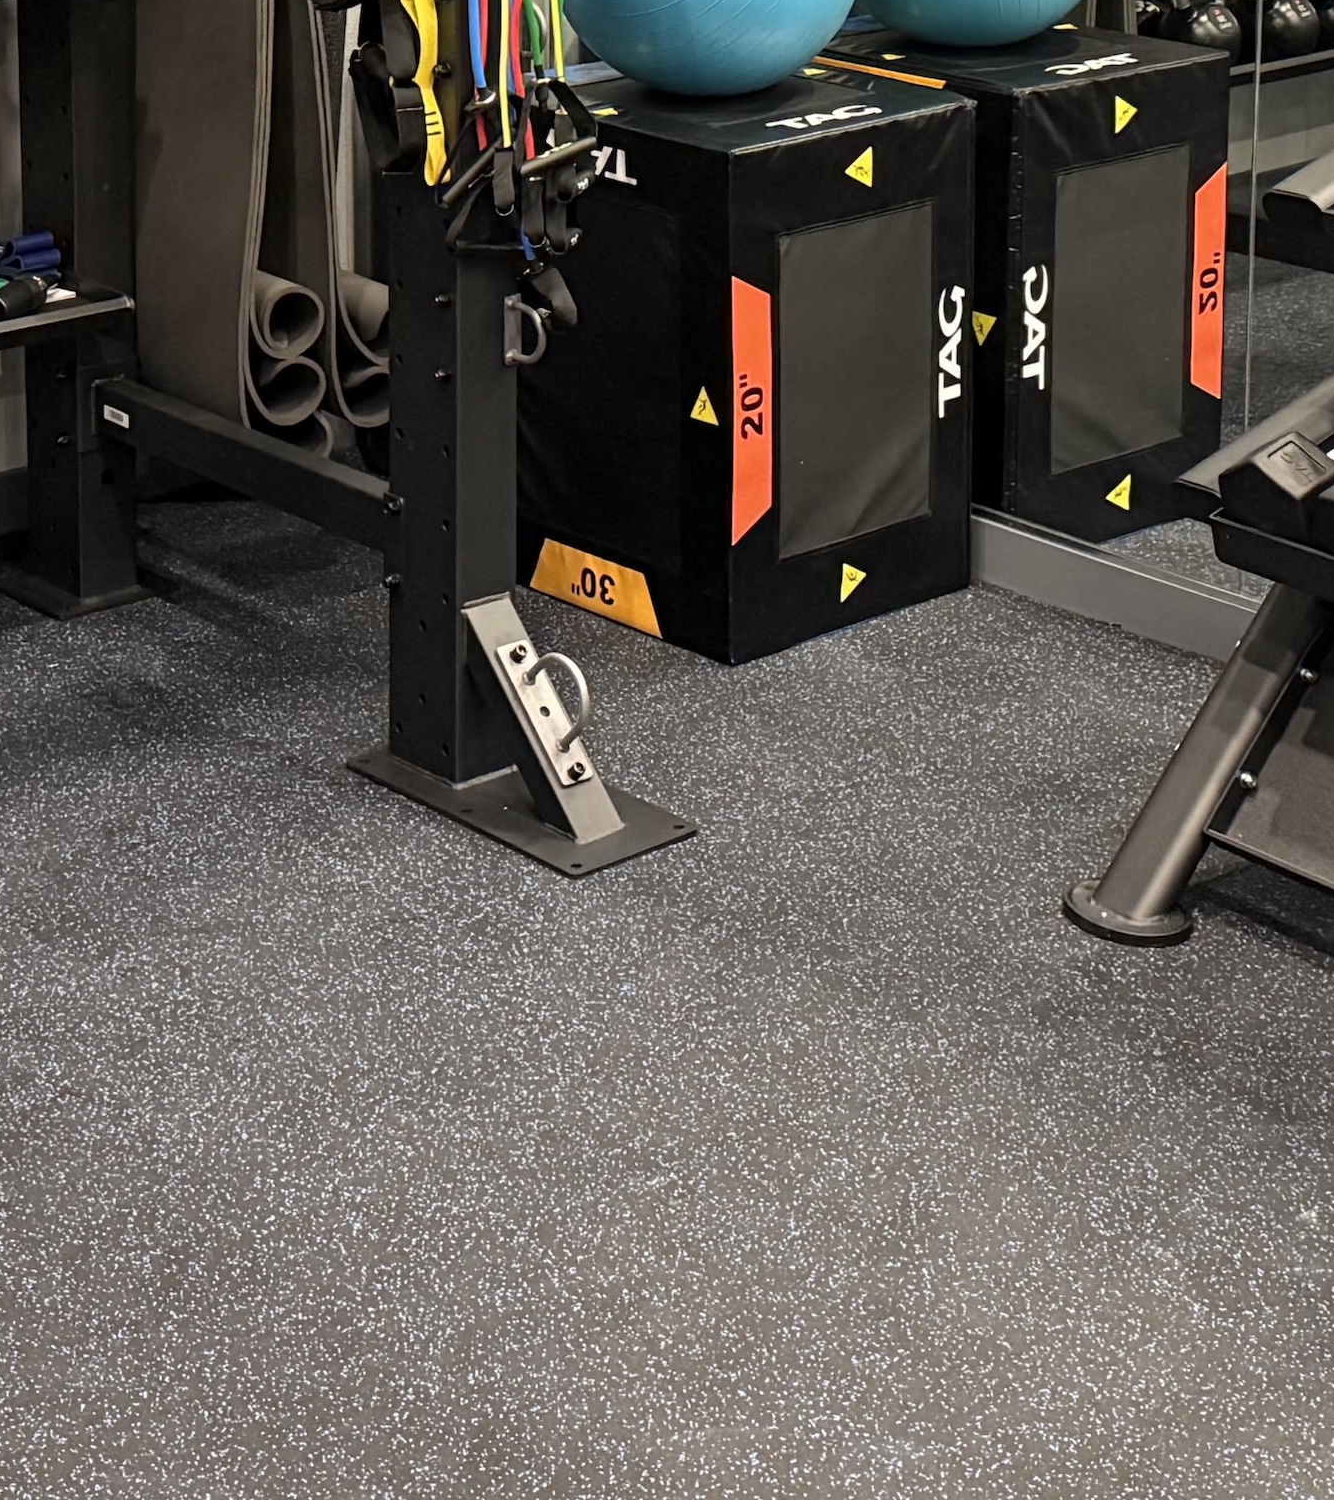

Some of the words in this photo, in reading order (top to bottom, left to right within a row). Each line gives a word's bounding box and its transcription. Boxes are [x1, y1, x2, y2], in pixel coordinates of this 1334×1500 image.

[765, 105, 883, 130] TAG
[938, 285, 966, 419] TAG
[739, 373, 764, 440] 20"
[571, 566, 616, 606] 30"
